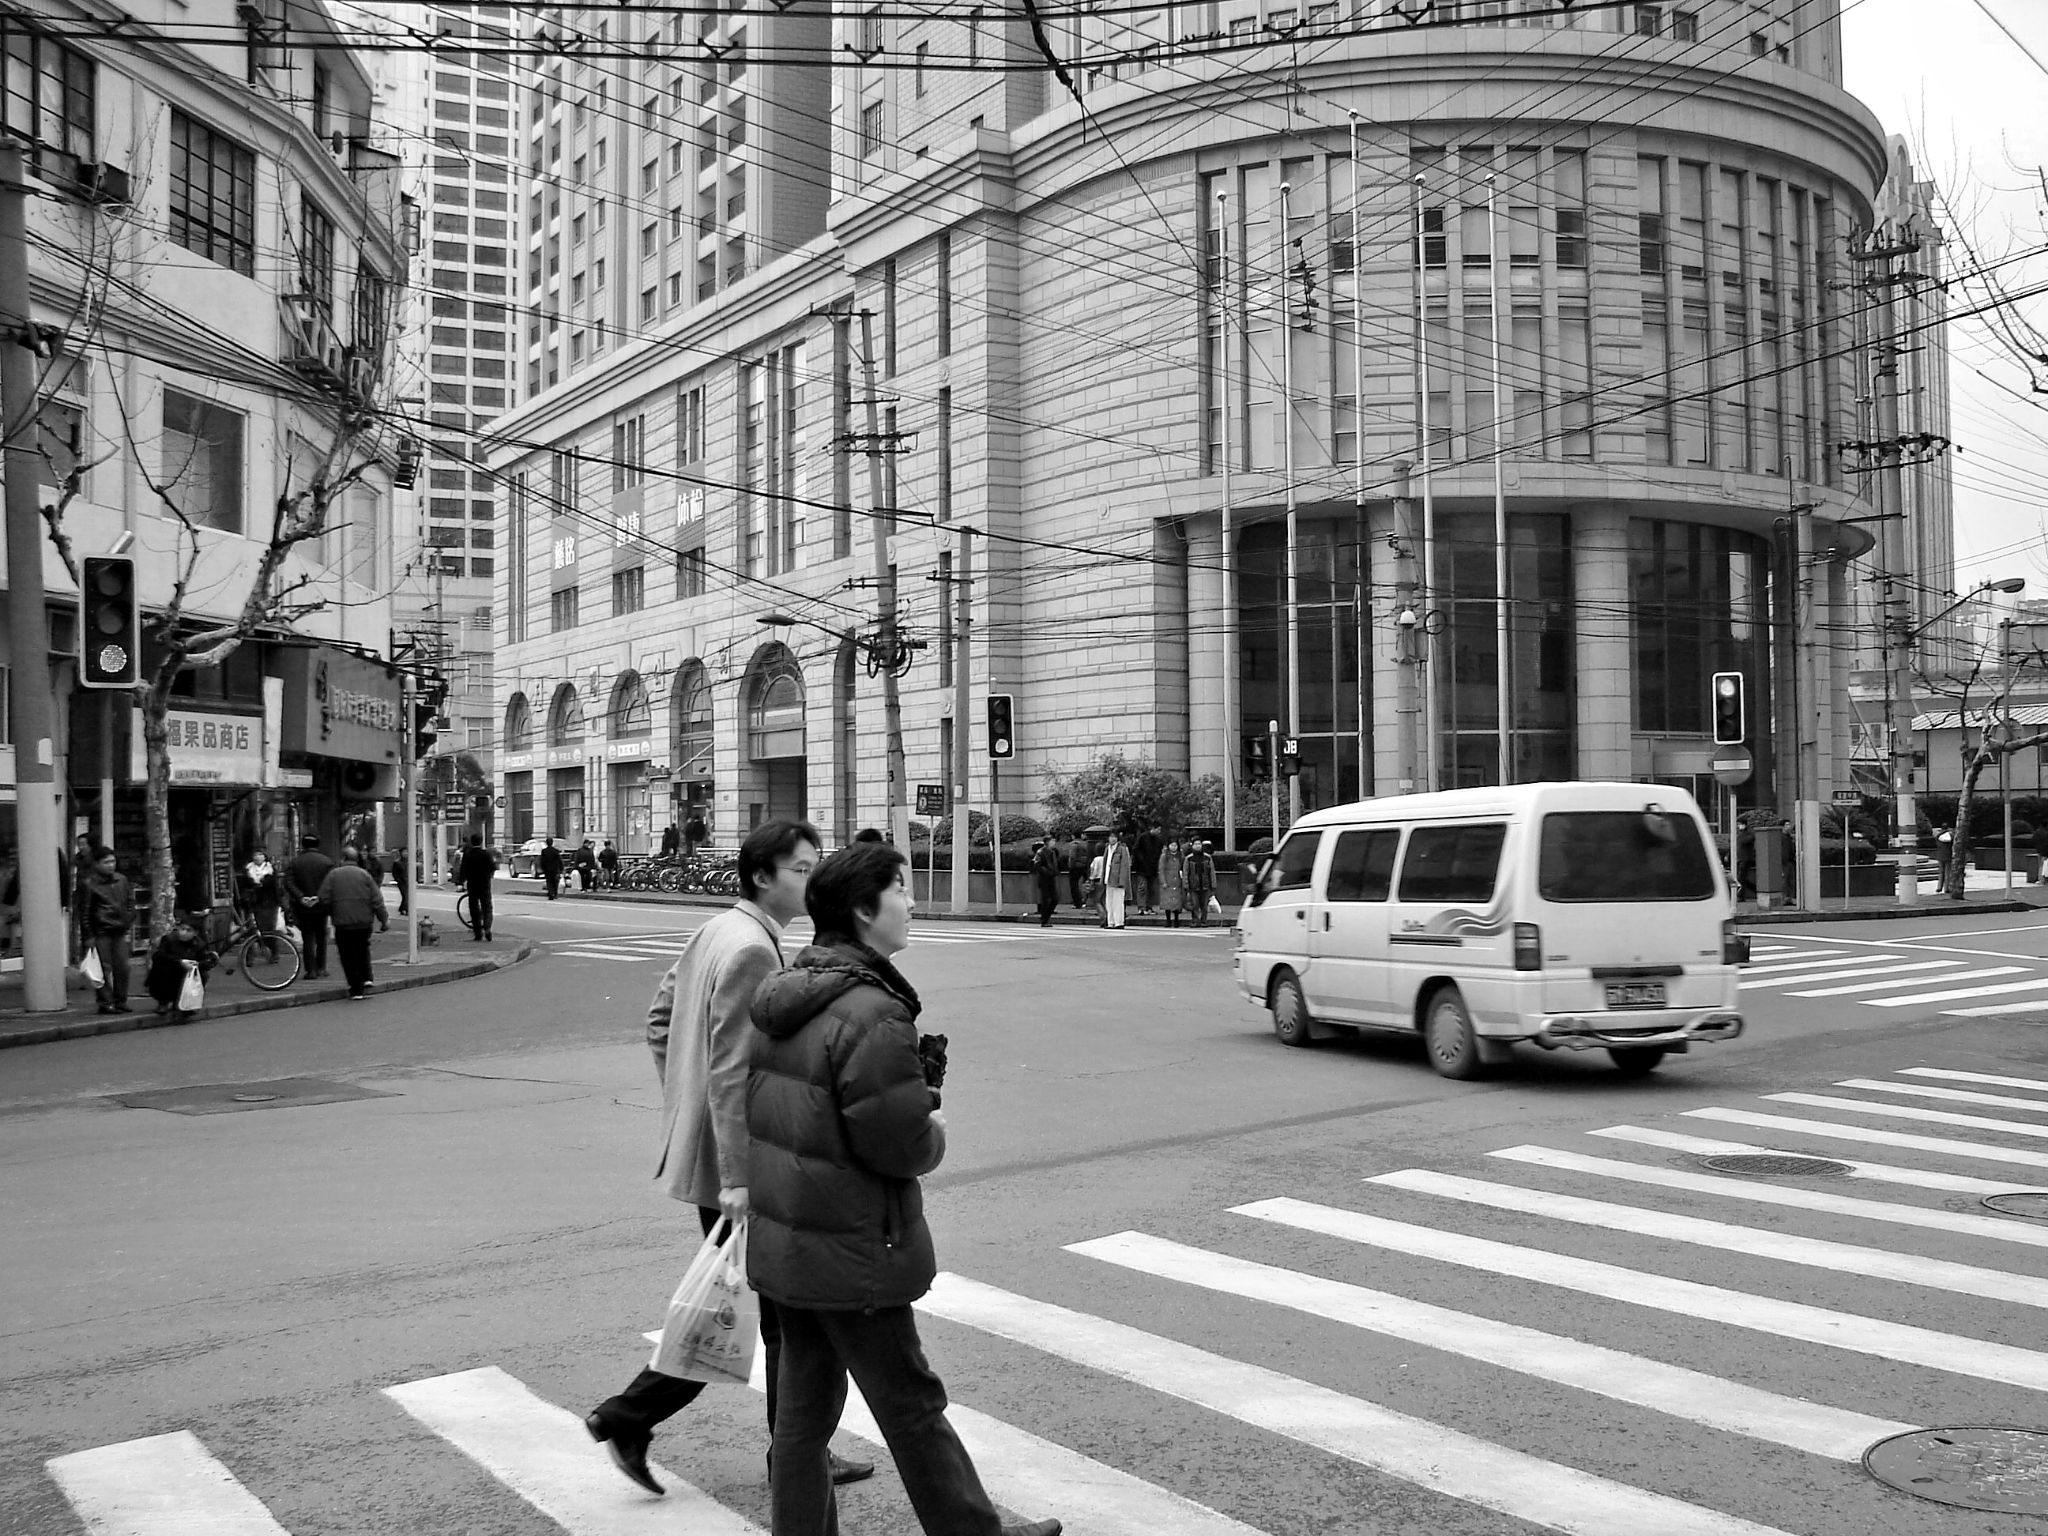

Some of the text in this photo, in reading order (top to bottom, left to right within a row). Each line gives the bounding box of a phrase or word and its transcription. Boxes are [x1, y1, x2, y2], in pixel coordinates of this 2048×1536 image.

[677, 488, 704, 528] 体检
[167, 718, 249, 750] 福果品商店
